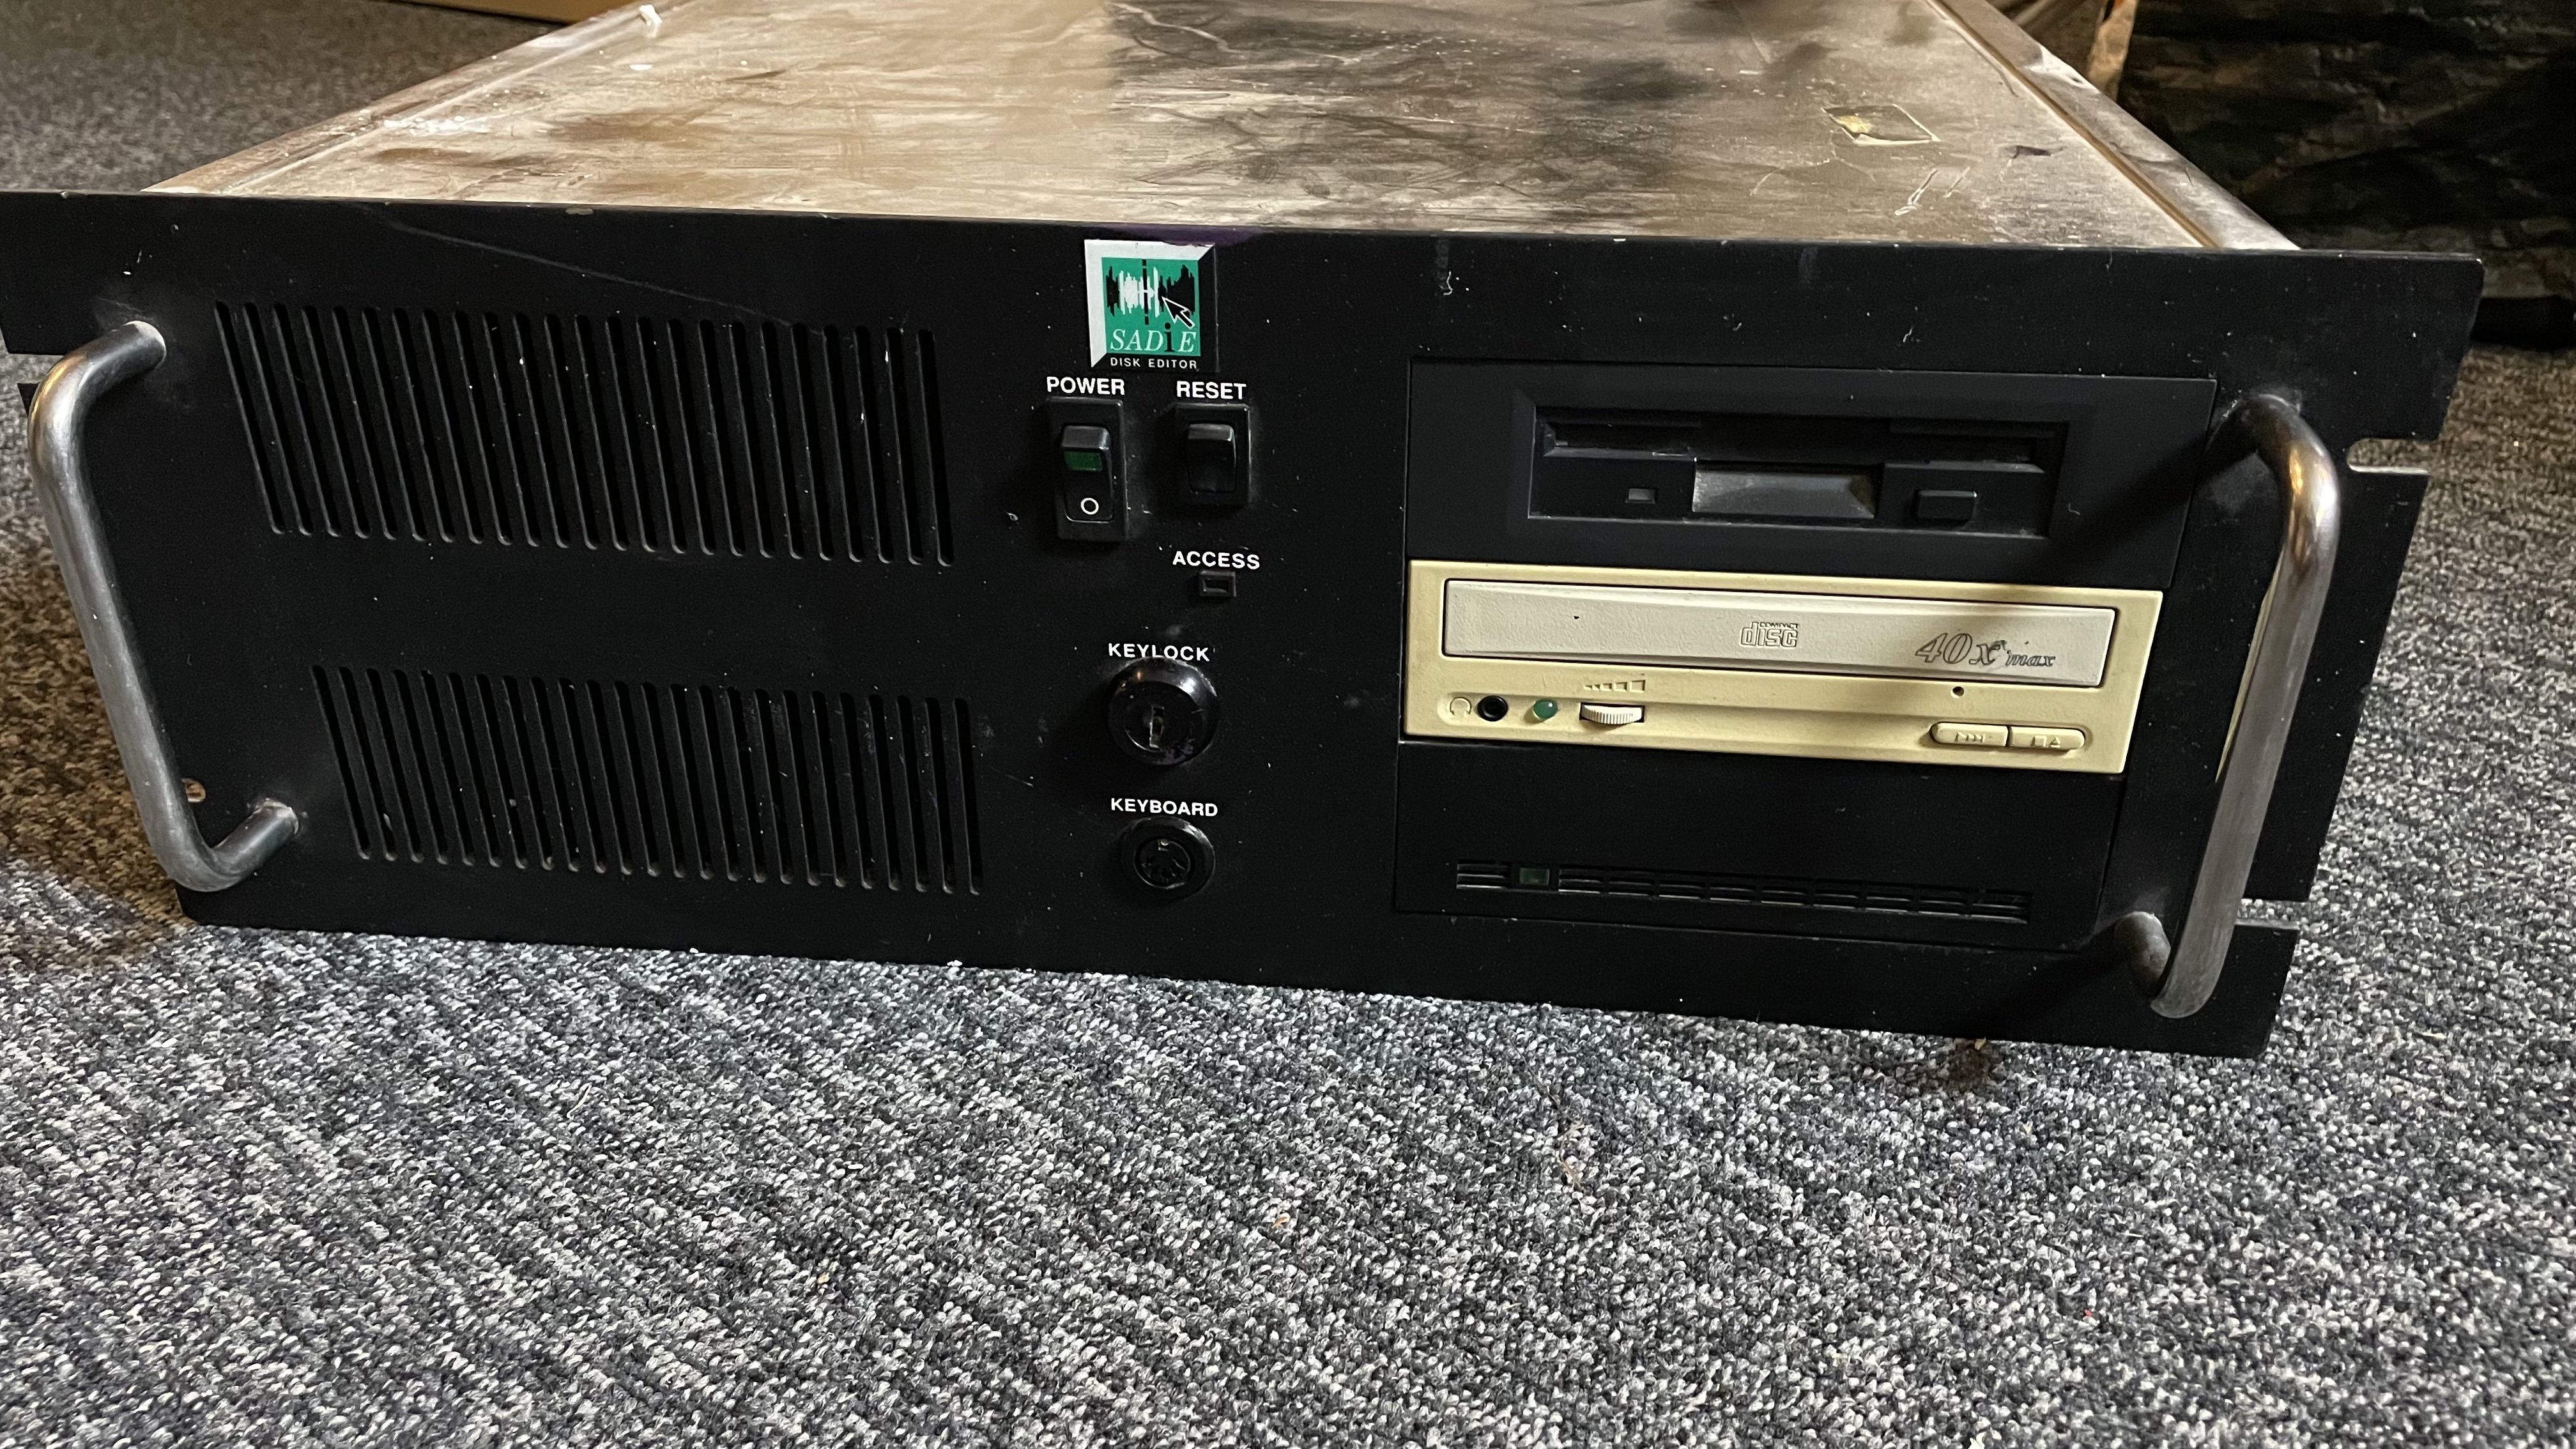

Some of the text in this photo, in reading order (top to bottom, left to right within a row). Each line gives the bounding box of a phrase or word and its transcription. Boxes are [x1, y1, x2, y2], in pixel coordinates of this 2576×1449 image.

[1110, 322, 1197, 353] SADiE
[1111, 358, 1196, 369] DISK EDITOR
[1047, 377, 1124, 395] POWER
[1177, 381, 1246, 399] RESET
[1172, 551, 1260, 570] ACCESS
[1740, 622, 1798, 648] disc
[1108, 643, 1210, 661] KEYLOCK
[1112, 798, 1217, 816] KEYBOARD
